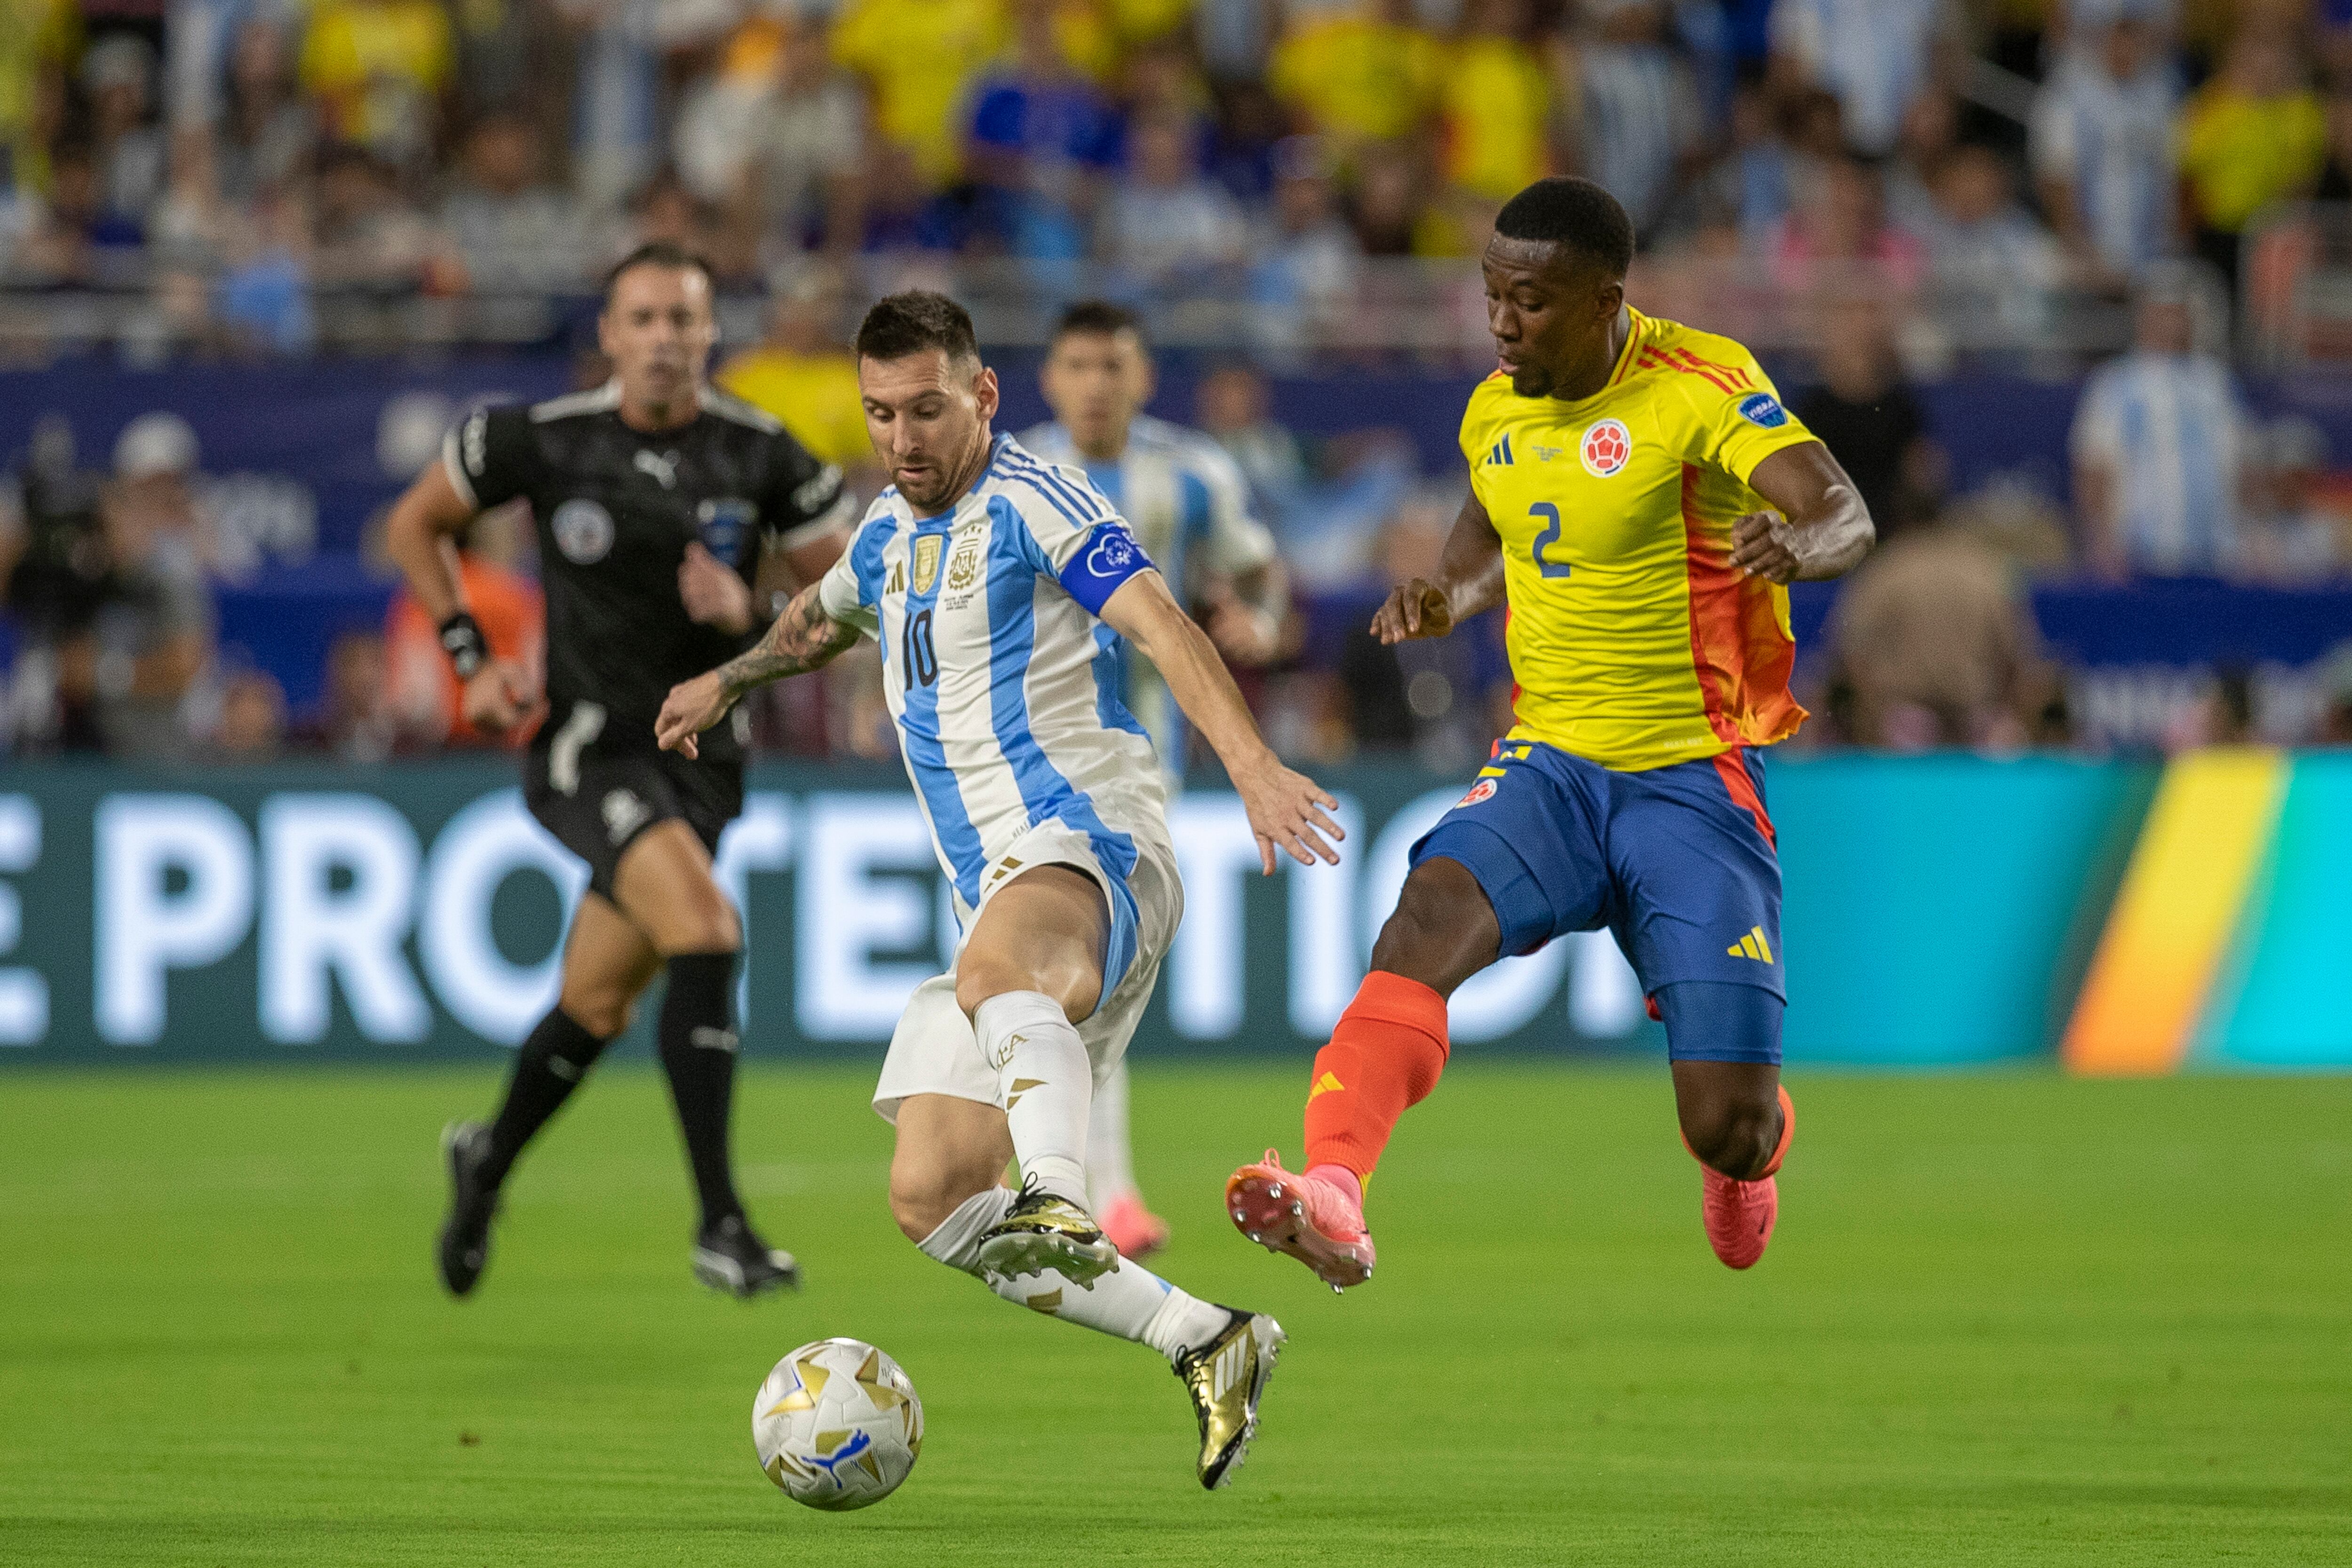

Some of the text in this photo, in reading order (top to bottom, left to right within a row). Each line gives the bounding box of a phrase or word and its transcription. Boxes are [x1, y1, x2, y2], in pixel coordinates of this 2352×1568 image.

[1528, 501, 1570, 577] 2
[903, 609, 937, 690] 10
[96, 783, 1644, 1044] PROETIO
